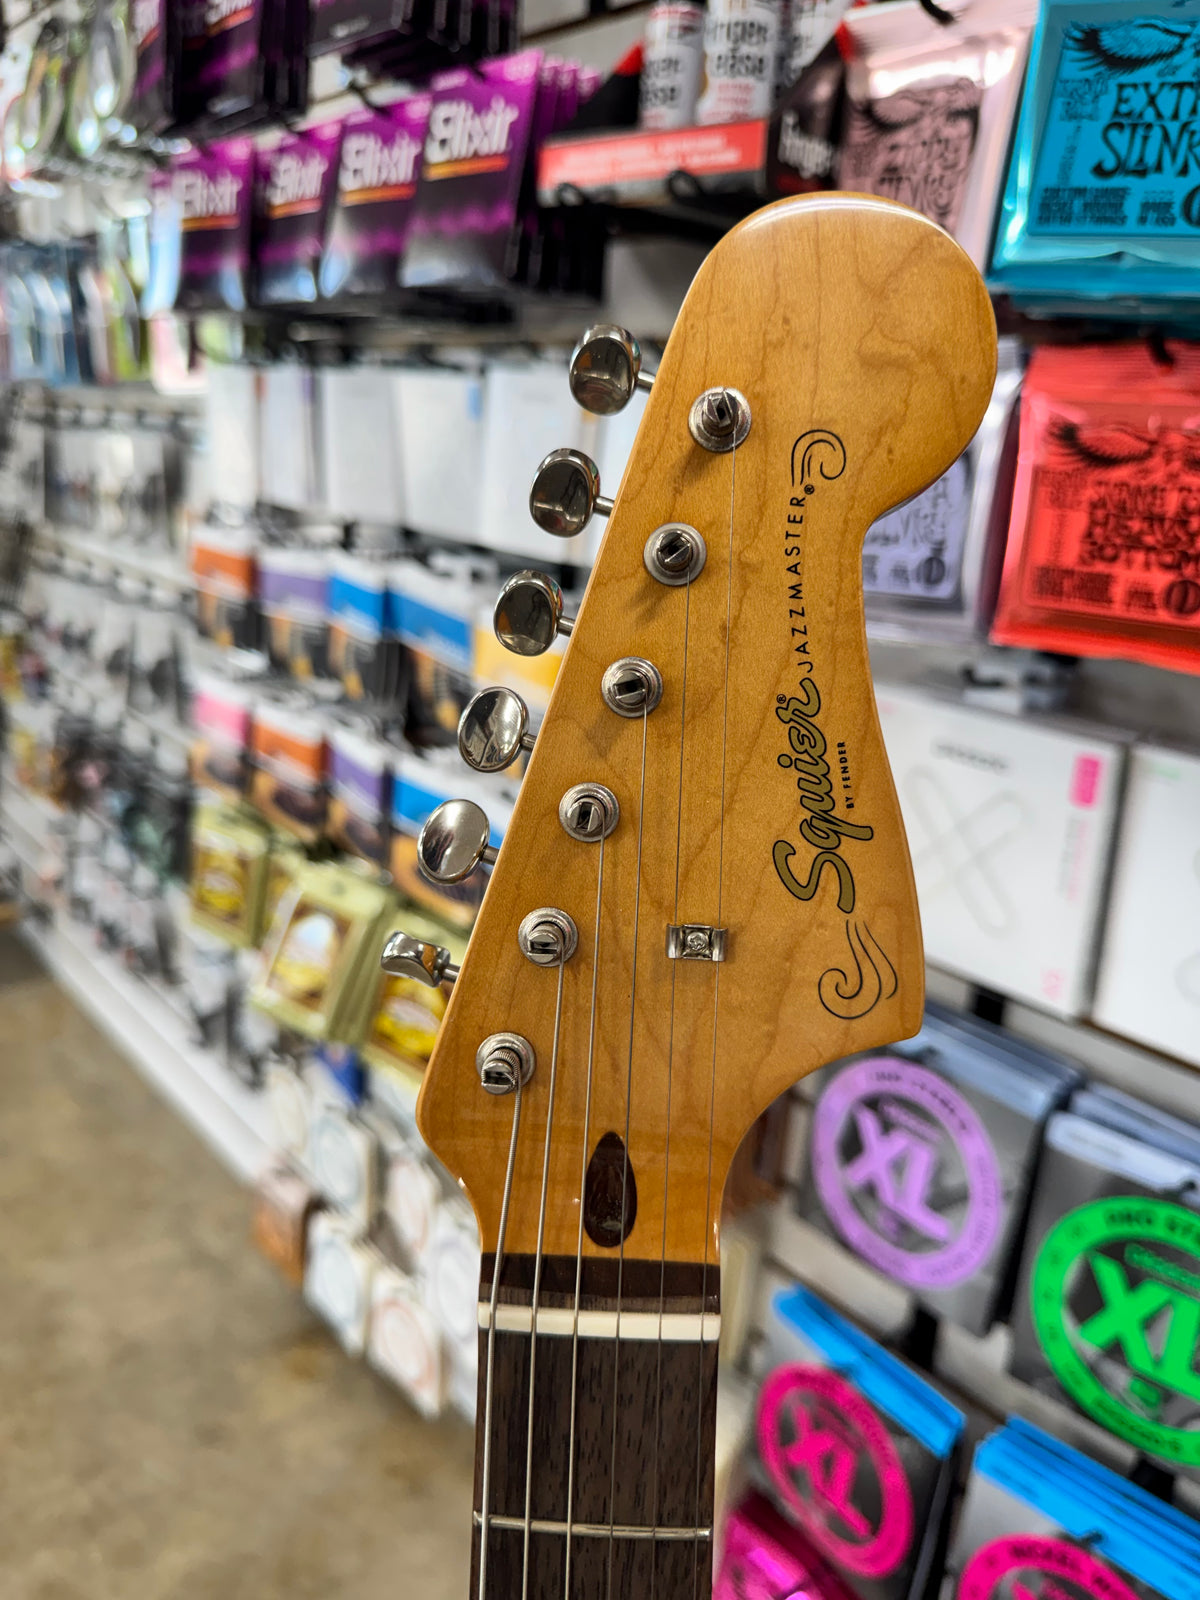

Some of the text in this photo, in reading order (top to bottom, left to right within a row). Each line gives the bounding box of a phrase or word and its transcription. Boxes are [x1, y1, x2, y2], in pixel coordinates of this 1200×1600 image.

[340, 132, 420, 194] Elixir
[427, 98, 519, 163] Elixir
[270, 153, 328, 205] Elixir
[772, 677, 874, 914] Squier
[836, 741, 856, 809] BY FENDER
[845, 1098, 952, 1242] XL
